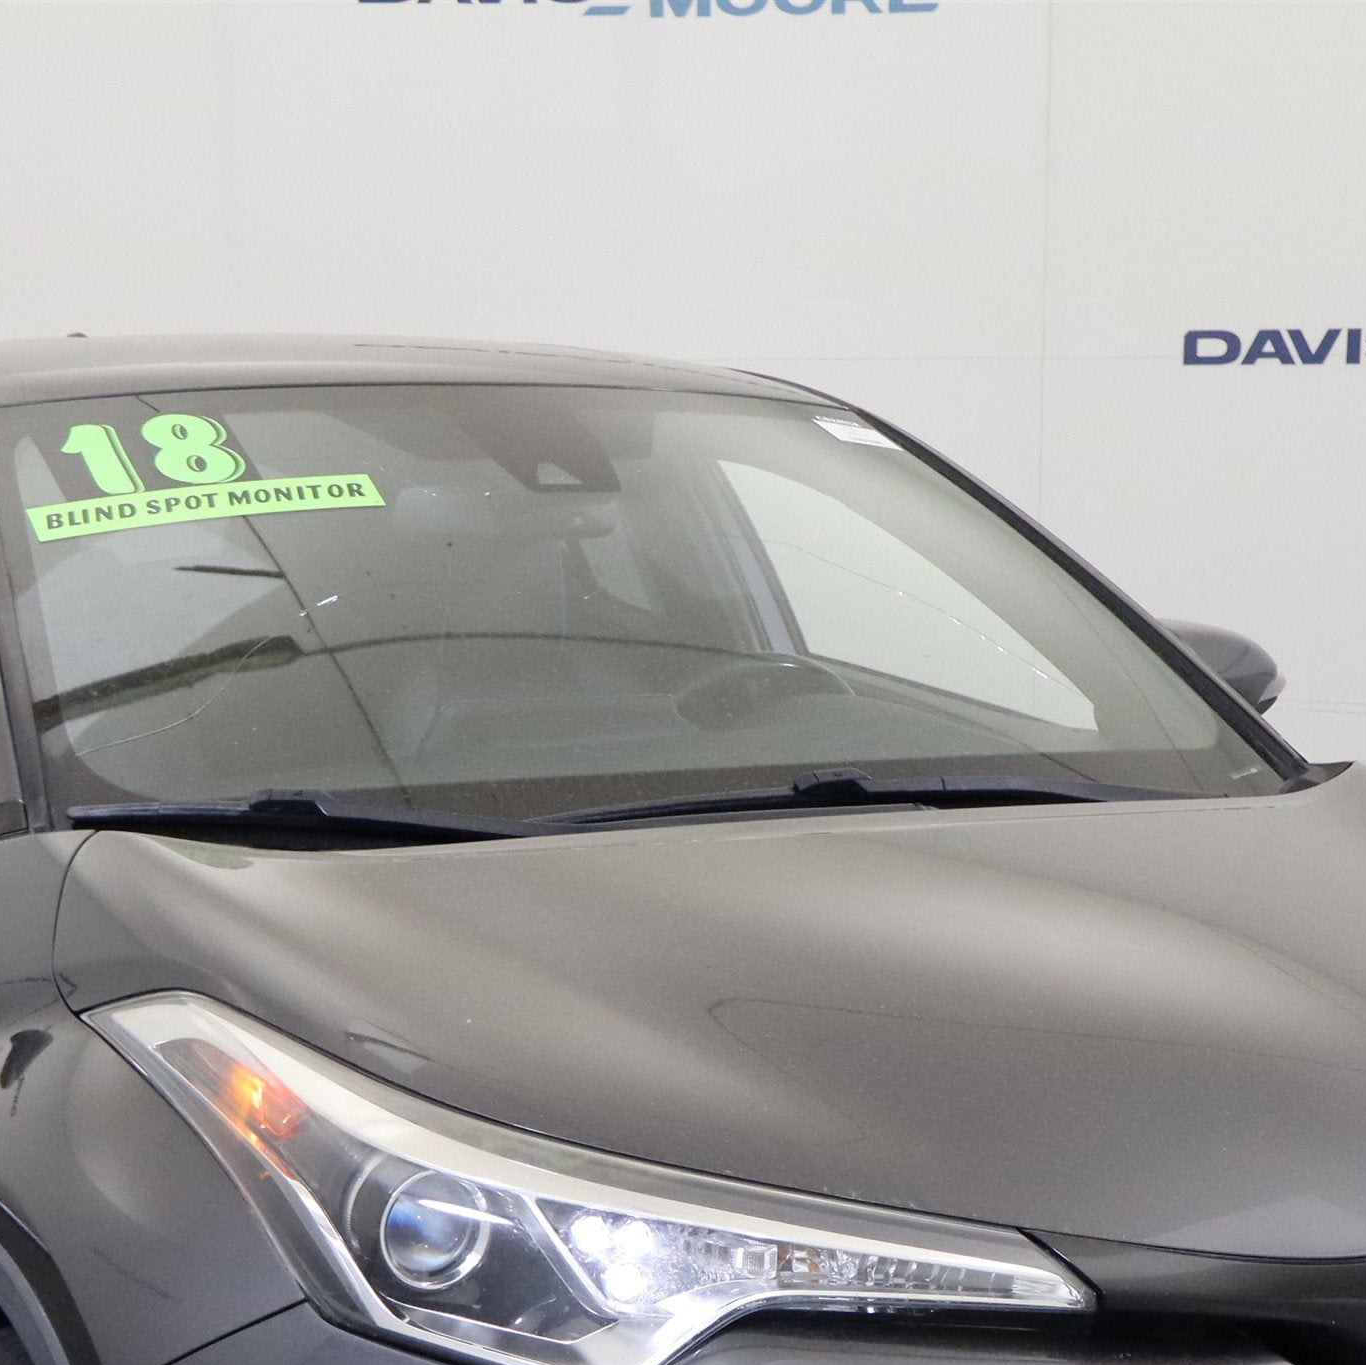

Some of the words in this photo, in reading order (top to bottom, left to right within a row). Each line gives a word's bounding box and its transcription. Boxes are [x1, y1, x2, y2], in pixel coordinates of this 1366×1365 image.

[60, 413, 246, 495] 18
[46, 502, 137, 530] BLIND
[146, 492, 219, 515] SPOT
[229, 481, 367, 507] MONITOR
